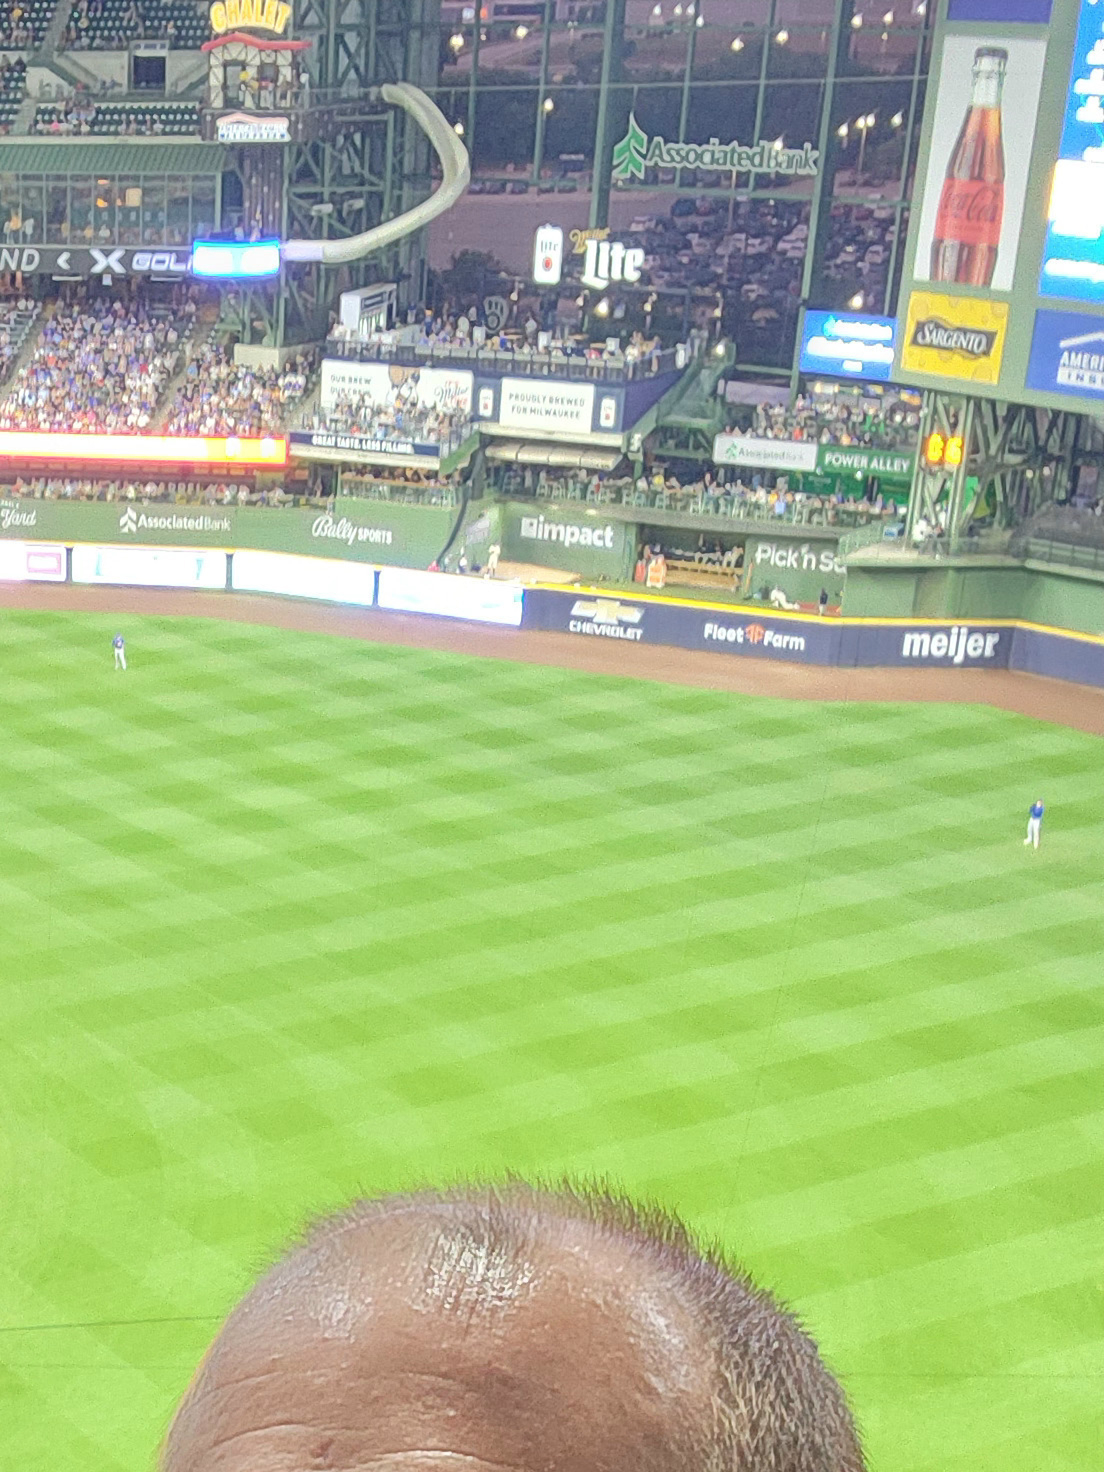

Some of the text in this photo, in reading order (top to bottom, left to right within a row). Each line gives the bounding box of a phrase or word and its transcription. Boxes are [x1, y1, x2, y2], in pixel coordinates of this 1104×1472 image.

[646, 136, 764, 173] Associated
[581, 240, 645, 290] Lite
[917, 322, 988, 354] SARGENTO
[509, 392, 585, 408] PROUDLY BREWED
[511, 405, 580, 419] FOR MILWAUKEE
[825, 453, 910, 473] POWER ALLEY
[0, 508, 36, 529] Yard
[138, 513, 232, 532] Associated Bank
[312, 515, 393, 546] Bally SPORTS
[537, 515, 613, 549] impact
[569, 618, 644, 641] CHEVROLET
[704, 623, 805, 651] Fleet Farm
[903, 626, 999, 664] meijer
